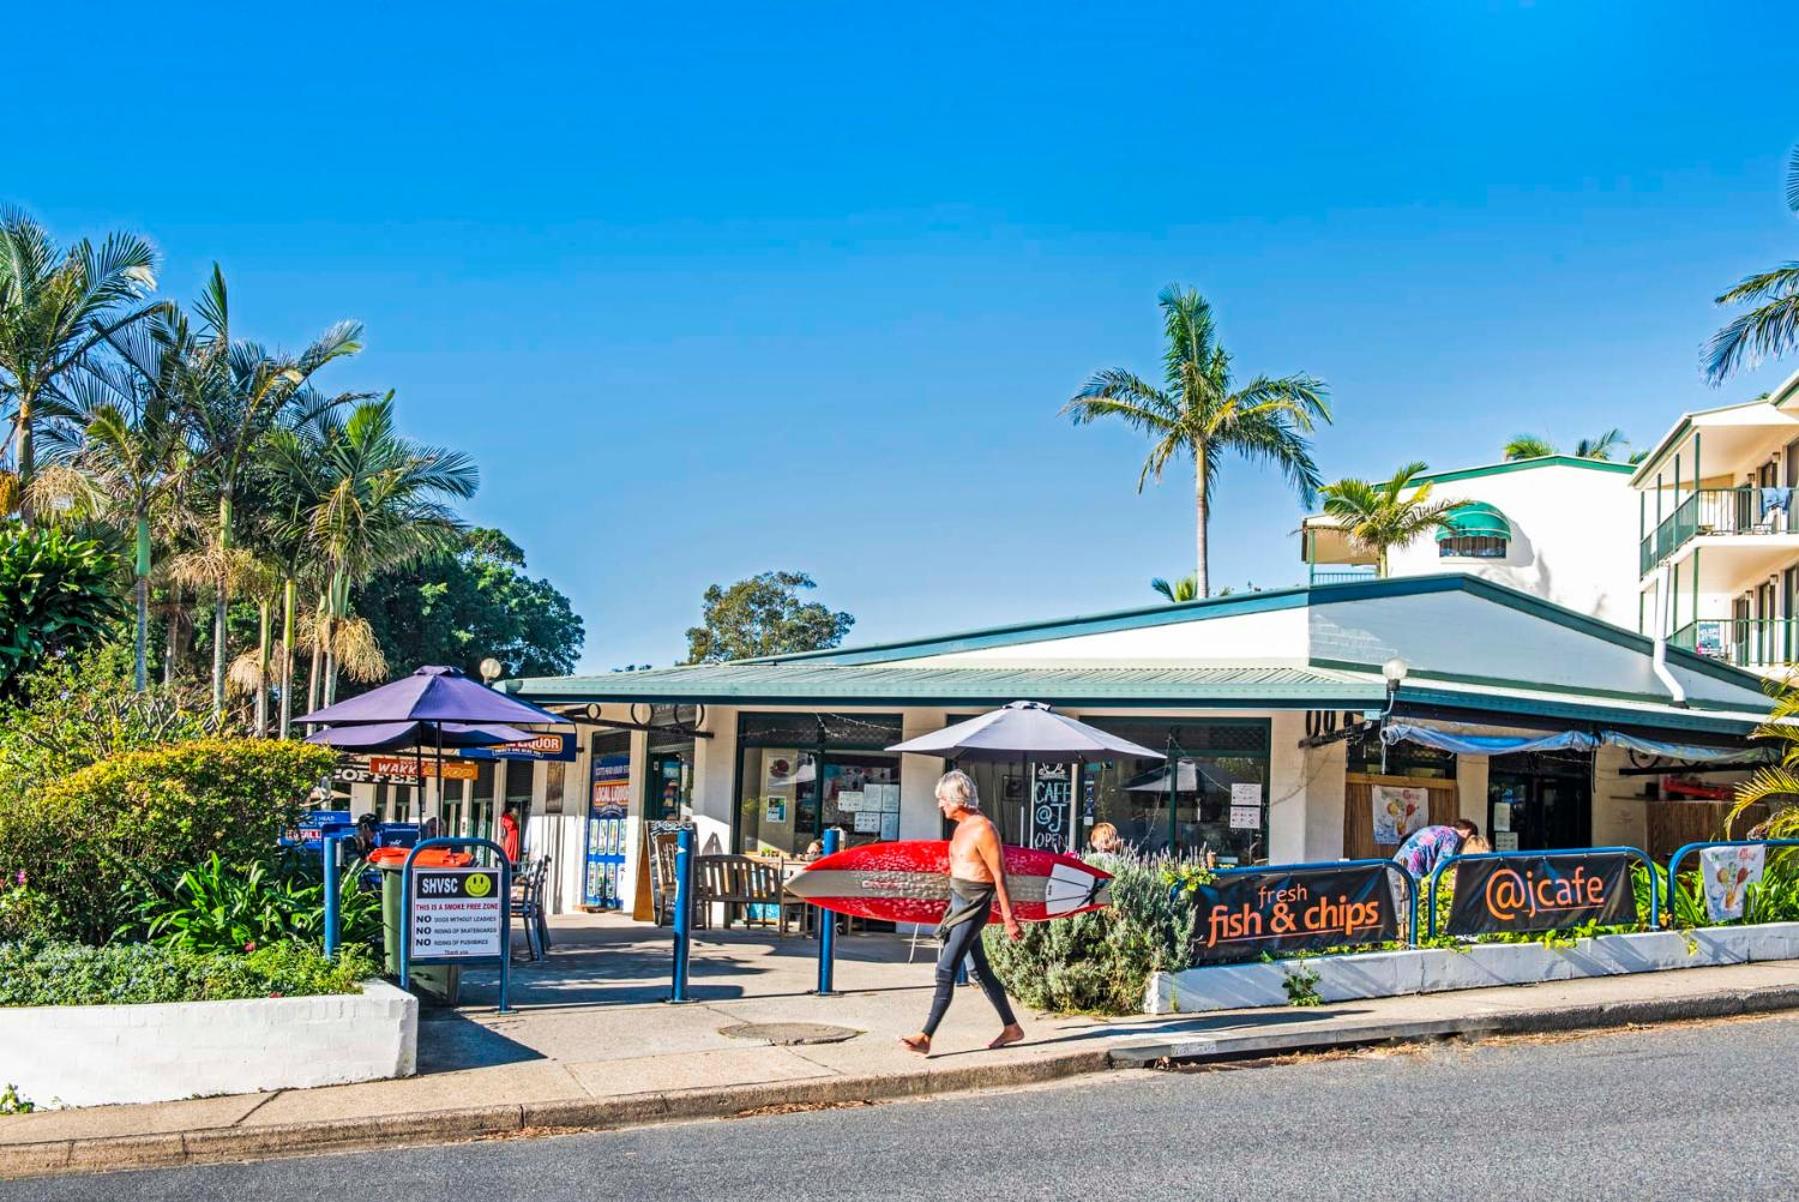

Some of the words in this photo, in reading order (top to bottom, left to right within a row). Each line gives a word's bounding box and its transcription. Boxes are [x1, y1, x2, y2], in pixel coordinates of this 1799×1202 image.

[378, 762, 419, 776] WAKK
[1034, 781, 1072, 804] CAFE
[422, 878, 458, 894] SHVSC
[1486, 865, 1604, 921] @jcafe
[1258, 883, 1308, 909] fresh
[482, 902, 499, 910] ZONE
[416, 915, 432, 923] NO
[1207, 903, 1262, 948] fish
[1269, 902, 1297, 933] &
[1304, 895, 1379, 936] chips
[416, 926, 432, 935] NO
[416, 938, 432, 946] NO
